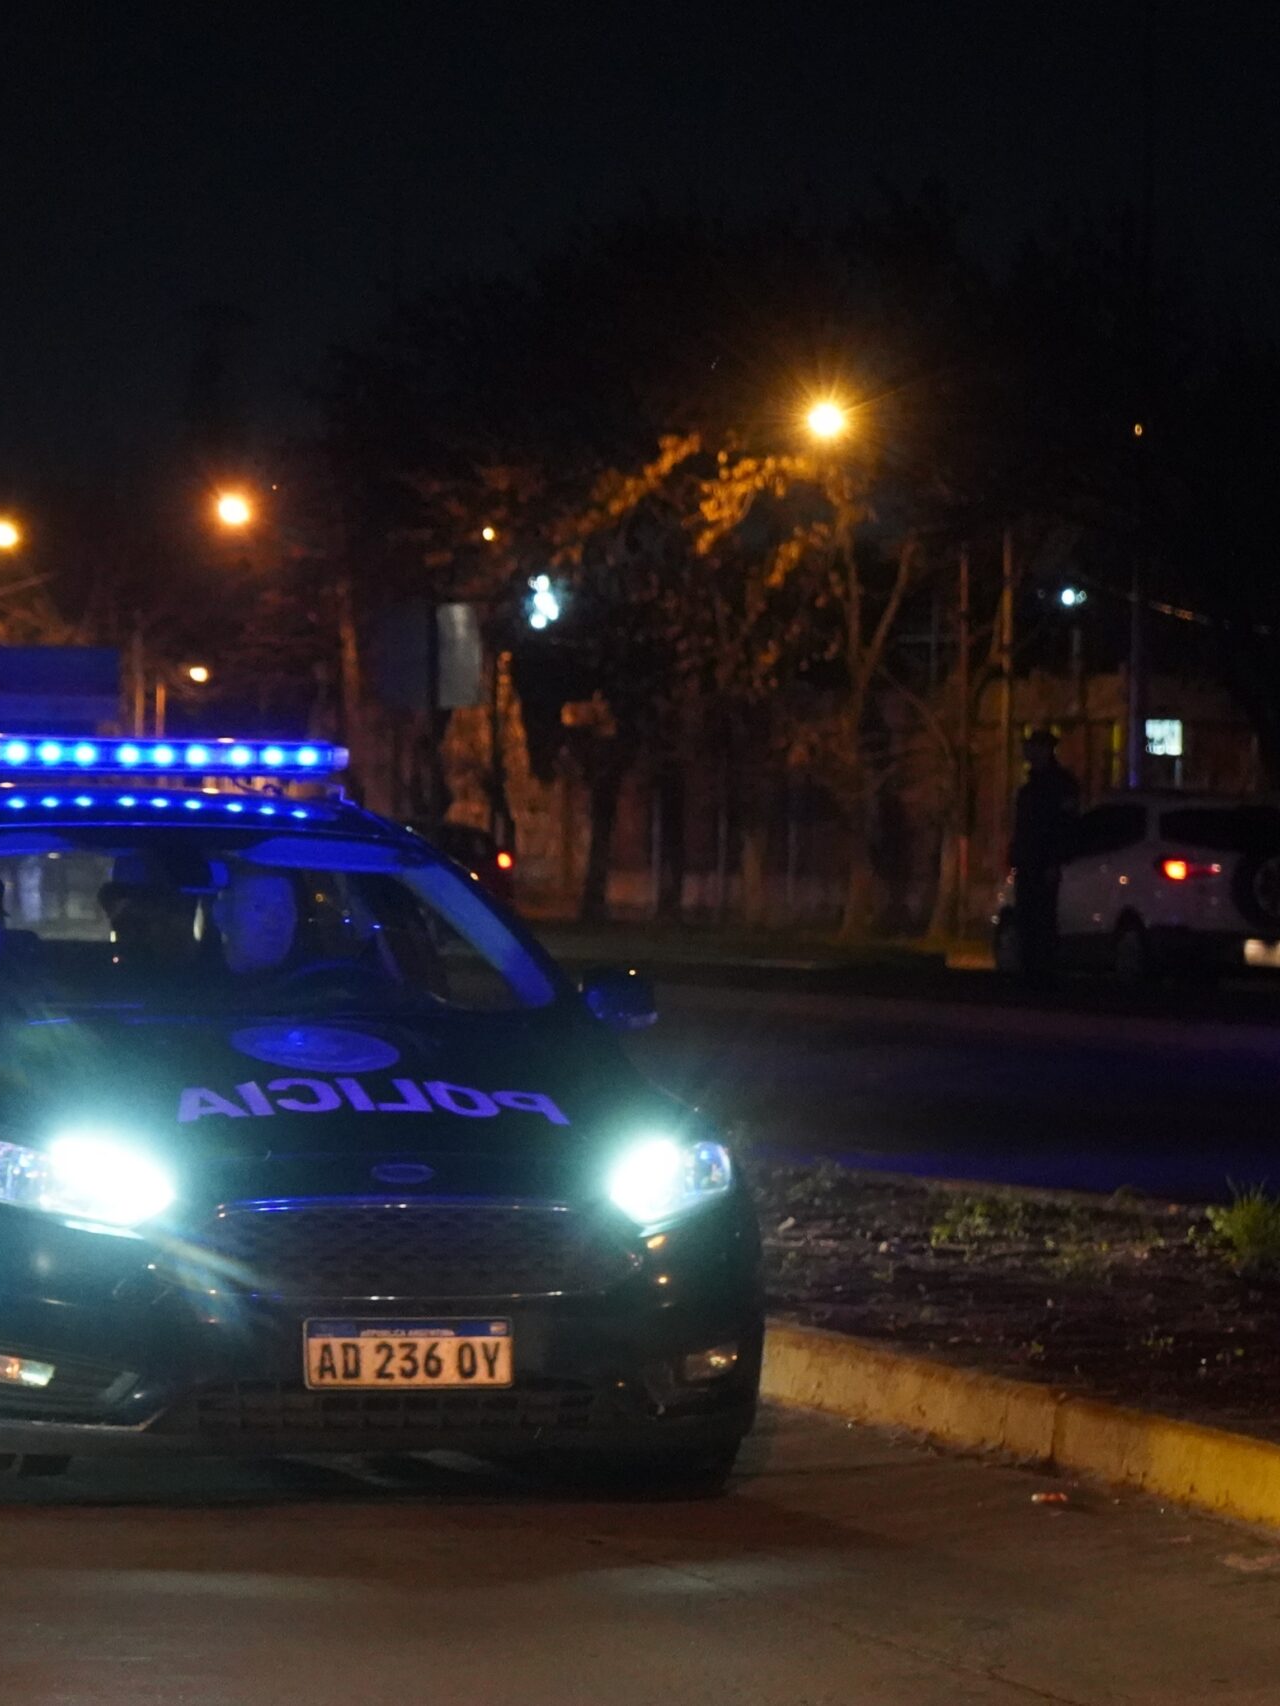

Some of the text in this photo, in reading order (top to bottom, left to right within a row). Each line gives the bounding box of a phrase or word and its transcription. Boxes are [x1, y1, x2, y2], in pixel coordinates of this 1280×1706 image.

[317, 1342, 500, 1380] AD 236 OY
